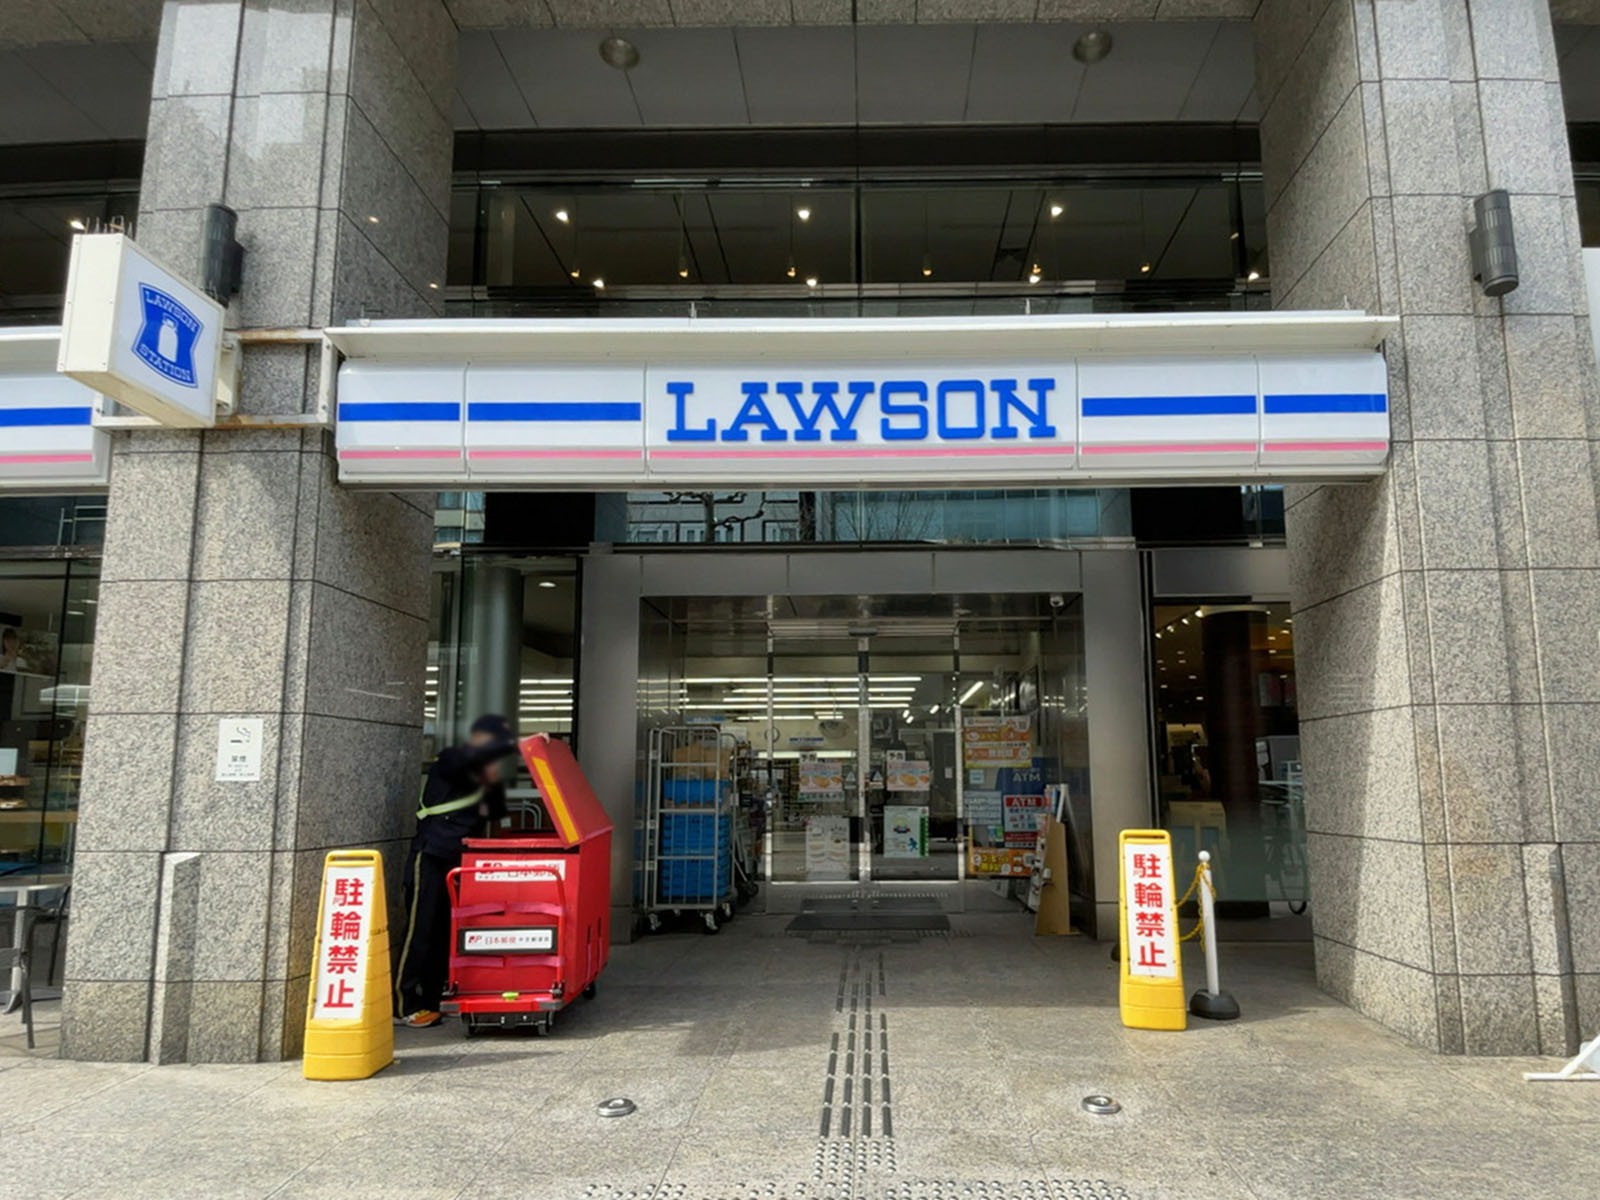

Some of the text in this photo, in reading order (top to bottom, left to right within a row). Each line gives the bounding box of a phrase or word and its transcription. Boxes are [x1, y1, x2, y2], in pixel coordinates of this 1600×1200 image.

[145, 291, 198, 333] LAWSON
[138, 343, 191, 381] STATION
[666, 378, 1056, 442] LAWSON
[1012, 772, 1041, 782] ATM
[1012, 797, 1036, 807] ATM
[1133, 853, 1167, 968] 駐輪禁止
[323, 878, 364, 1008] 駐輪禁止
